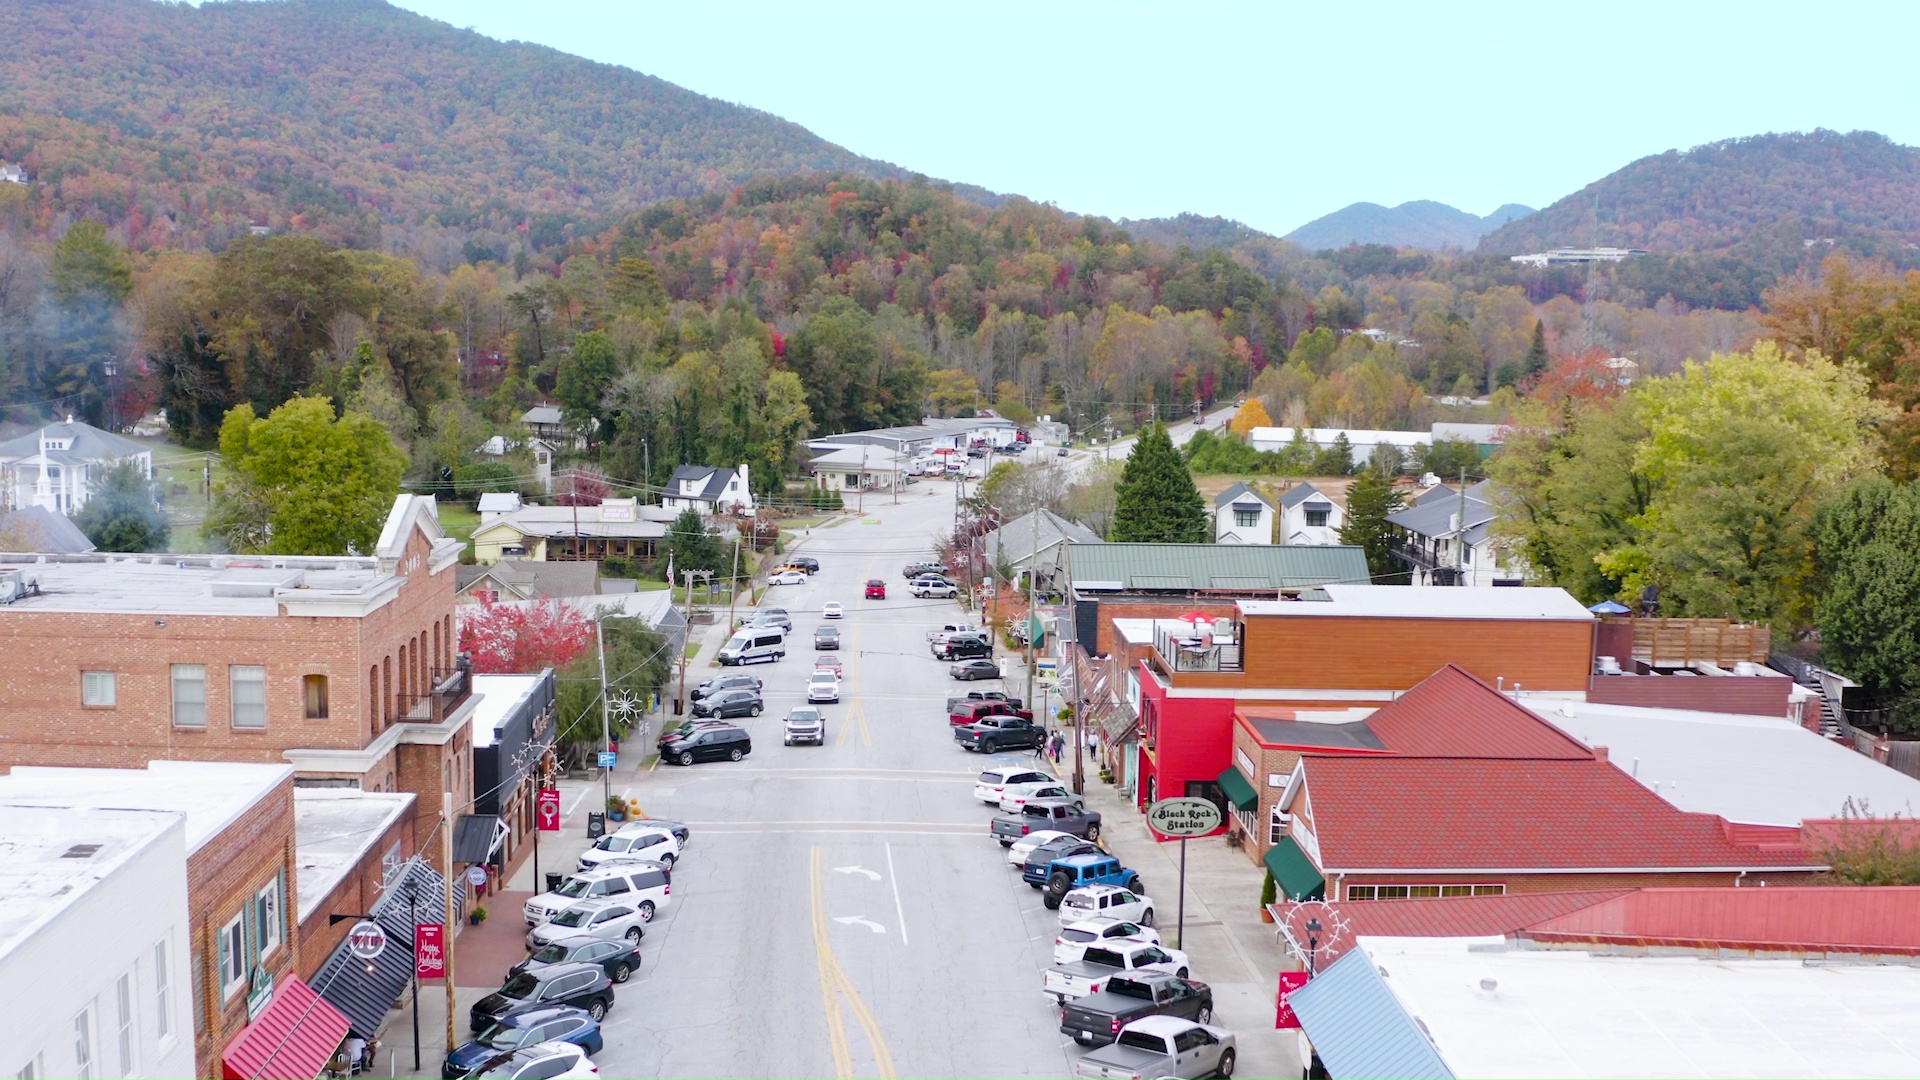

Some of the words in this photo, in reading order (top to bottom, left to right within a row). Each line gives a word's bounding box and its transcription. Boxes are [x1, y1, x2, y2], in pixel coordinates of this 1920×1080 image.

[1158, 810, 1185, 819] Black
[1188, 809, 1211, 819] Rock
[1167, 820, 1204, 830] Station
[421, 939, 440, 955] Happy
[418, 952, 443, 972] Holidays
